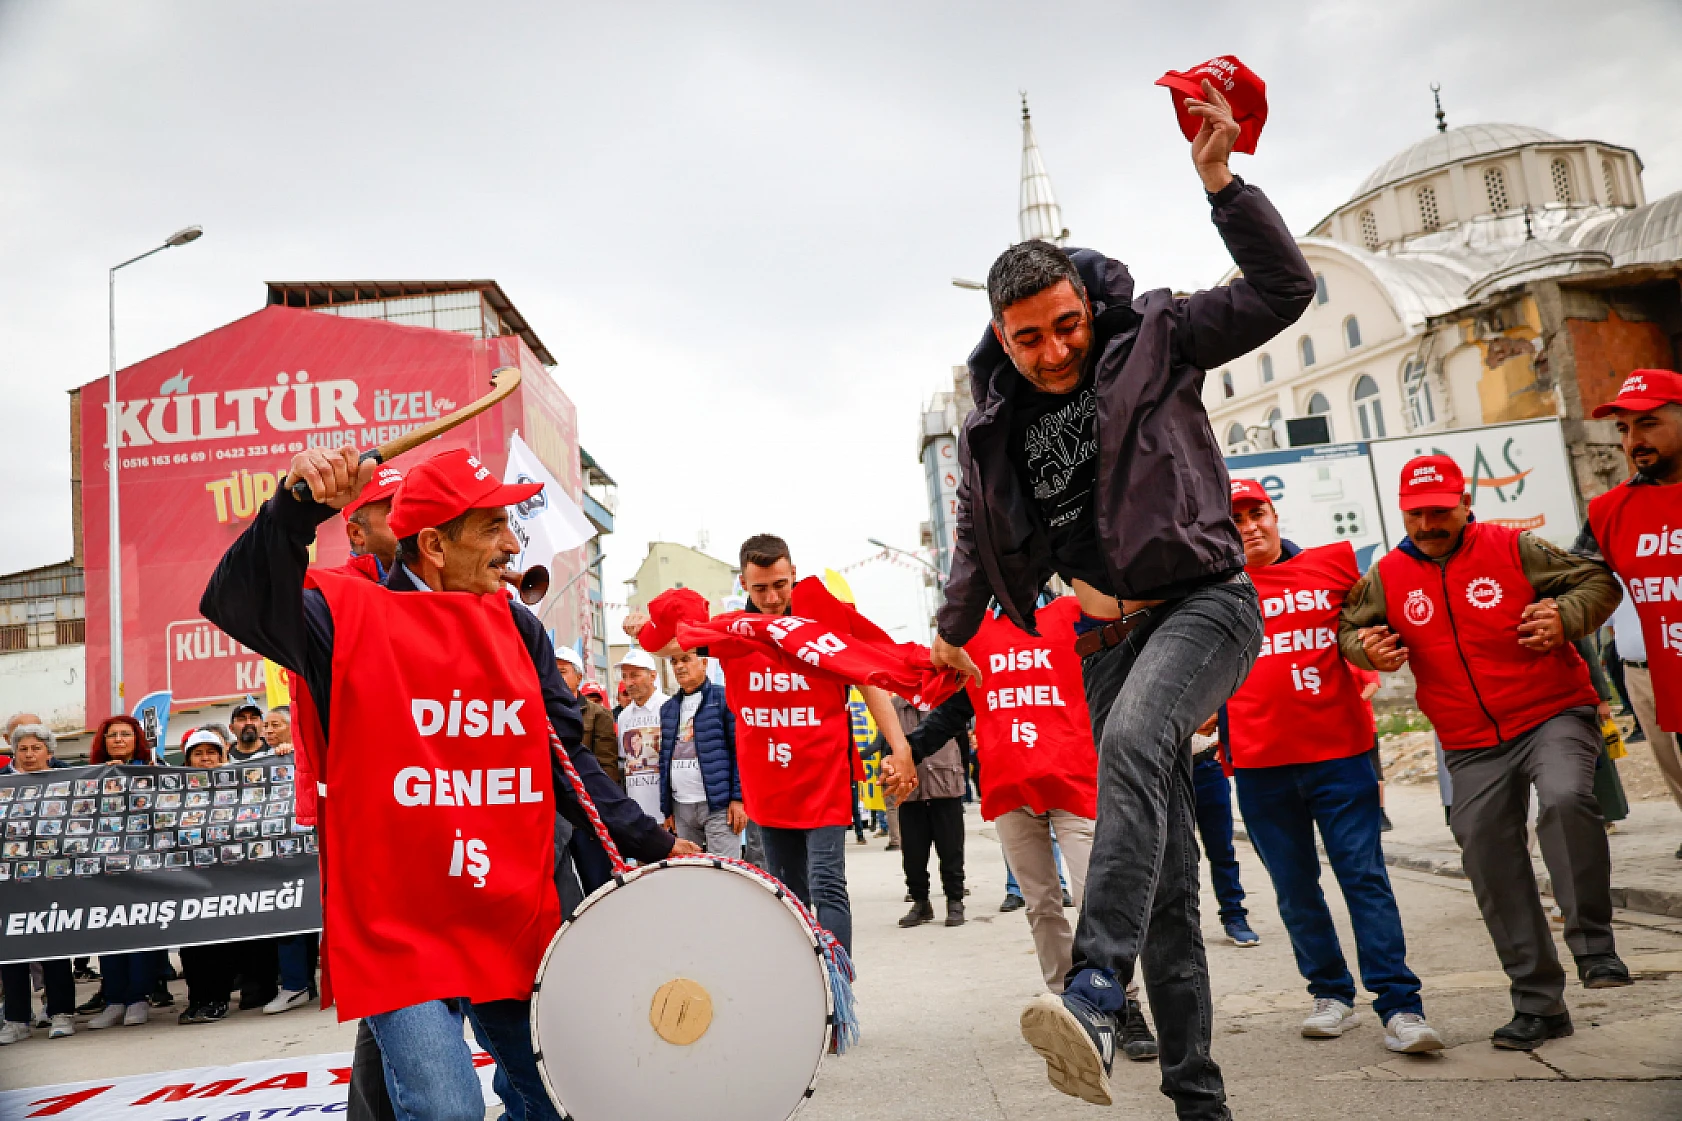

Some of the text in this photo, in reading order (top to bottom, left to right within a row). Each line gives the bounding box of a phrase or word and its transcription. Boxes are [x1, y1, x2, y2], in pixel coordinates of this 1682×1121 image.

[374, 389, 441, 422] ÖZEL
[306, 429, 357, 452] KURS
[1262, 588, 1332, 618] DİSK
[988, 647, 1054, 674] DİSK
[749, 666, 811, 692] DİSK
[1291, 663, 1322, 695] İŞ
[412, 689, 527, 738] DİSK
[986, 685, 1067, 712] GENEL
[741, 706, 822, 728] GENEL
[1011, 717, 1039, 748] İŞ
[768, 737, 792, 768] İŞ
[393, 766, 544, 807] GENEL
[448, 828, 491, 888] İŞ
[6, 878, 306, 936] EKİM BARIŞ DERNEĞİ
